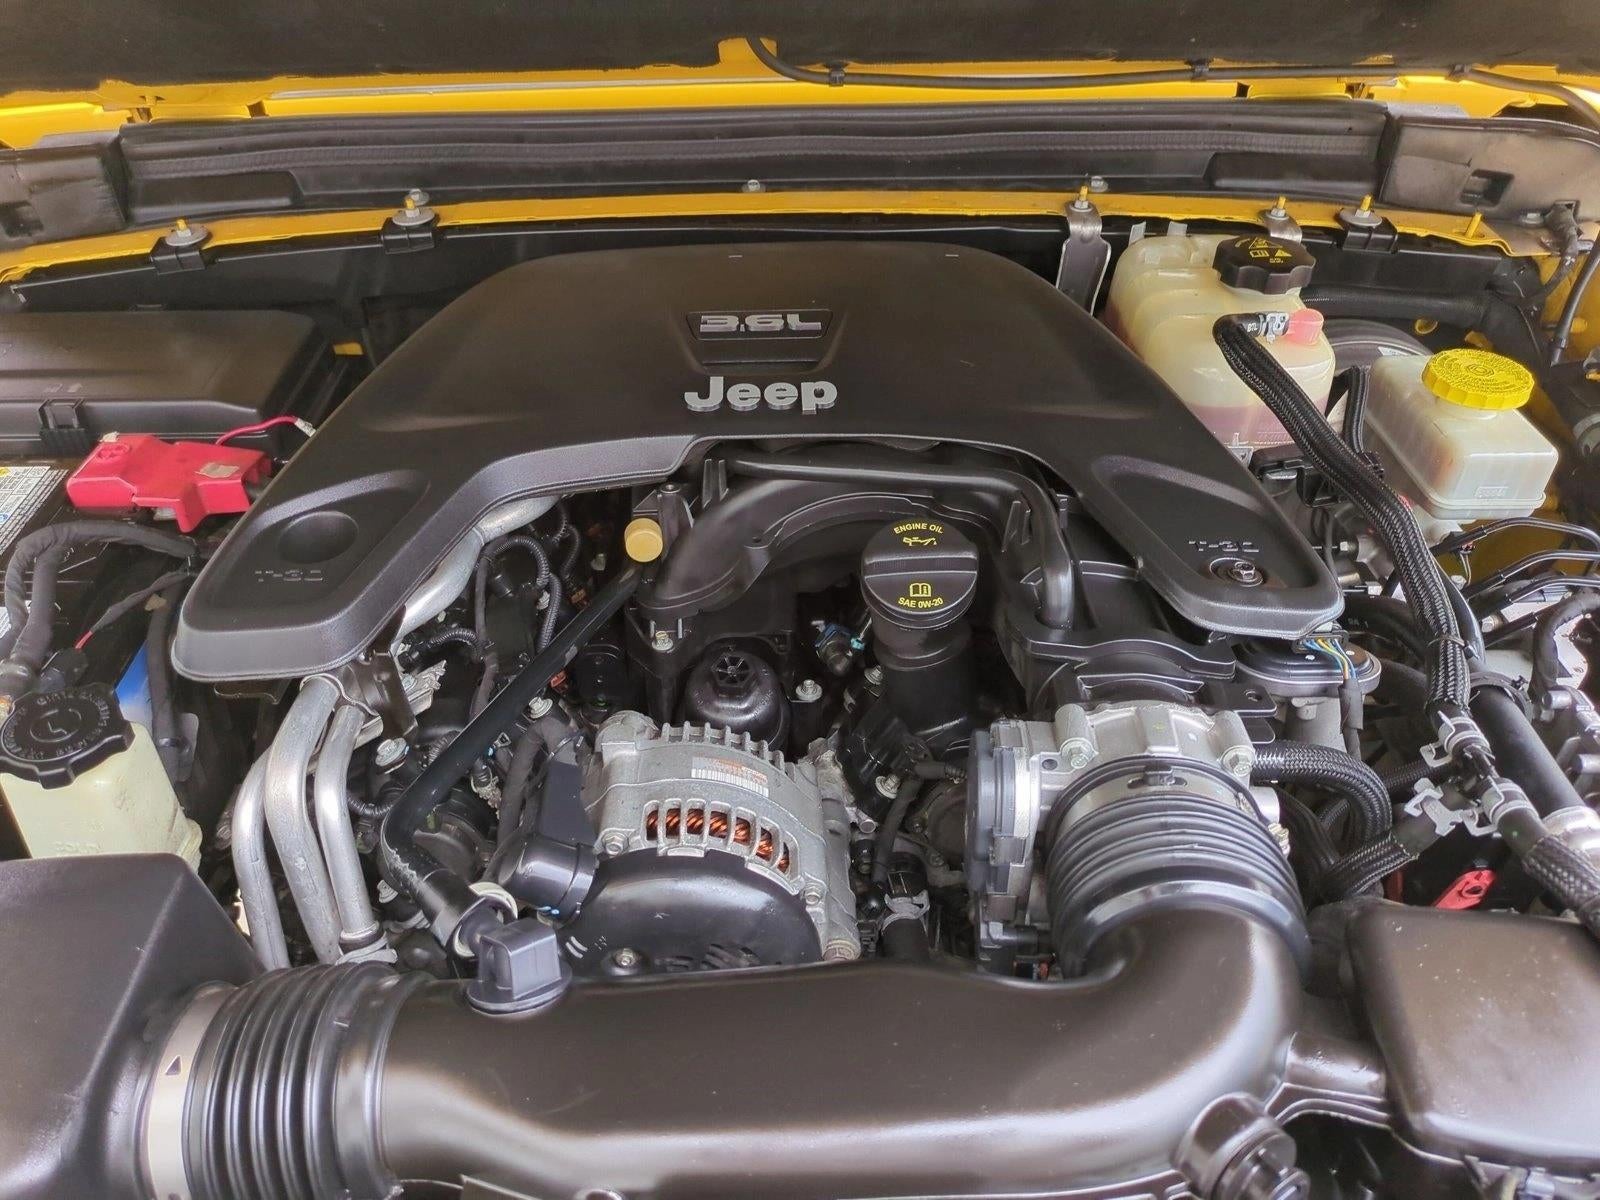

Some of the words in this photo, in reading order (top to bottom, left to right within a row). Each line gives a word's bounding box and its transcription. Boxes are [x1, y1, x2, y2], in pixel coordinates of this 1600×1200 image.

[699, 313, 822, 333] 3.6L
[684, 376, 838, 415] Jeep
[893, 522, 927, 534] ENGINE
[929, 524, 944, 534] OIL
[898, 597, 916, 608] SAE
[918, 597, 944, 608] 0W-20
